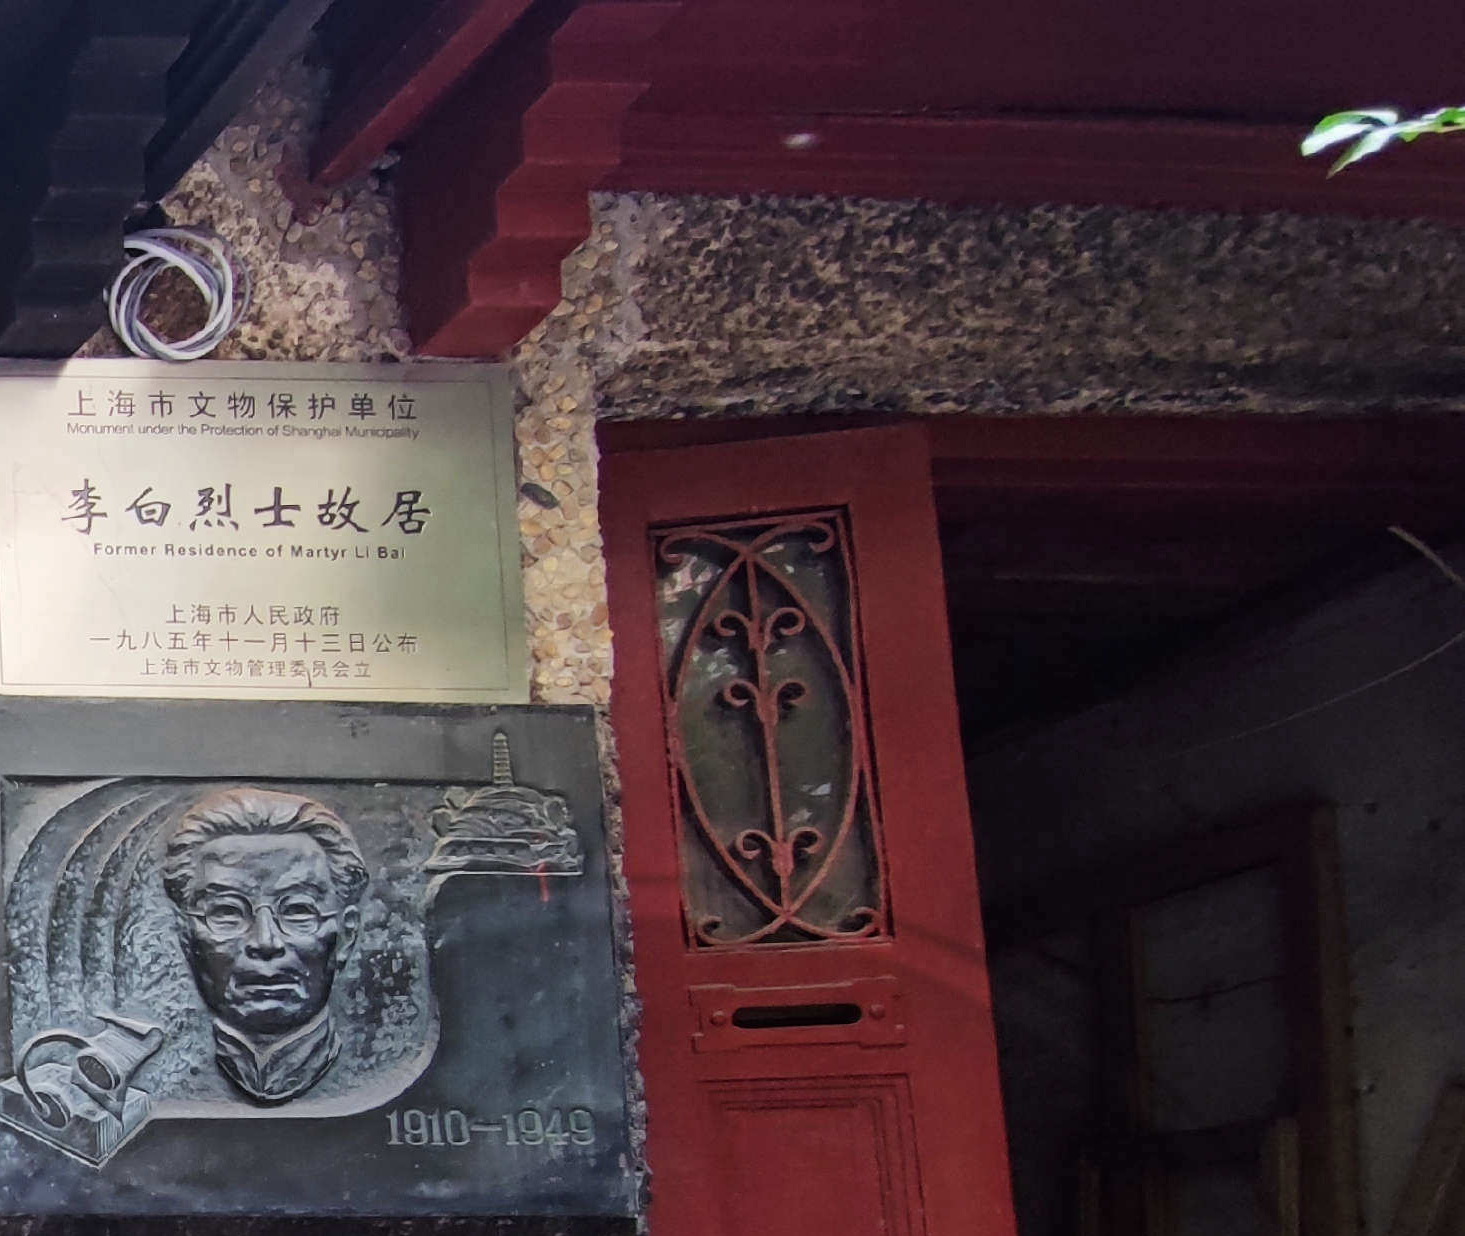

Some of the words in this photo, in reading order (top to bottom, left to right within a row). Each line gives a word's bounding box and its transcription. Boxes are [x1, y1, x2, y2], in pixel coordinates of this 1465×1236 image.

[67, 390, 417, 421] 上海市文物保护单位
[67, 423, 134, 435] Monument
[138, 423, 173, 435] under
[178, 424, 197, 435] the
[201, 424, 263, 436] Protection
[267, 425, 280, 437] of
[283, 425, 341, 439] Shanghai
[346, 426, 419, 440] Municipality
[61, 478, 433, 536] 李白烈士故居
[93, 543, 157, 557] Former
[165, 543, 257, 557] Residence
[266, 545, 283, 558] of
[291, 545, 347, 562] Martyr
[378, 546, 406, 560] Bai
[165, 605, 341, 626] 上海市人民政府
[89, 631, 418, 654] 一九八五年十一月十三日公布
[140, 658, 372, 680] 上海市文物管理委员会立
